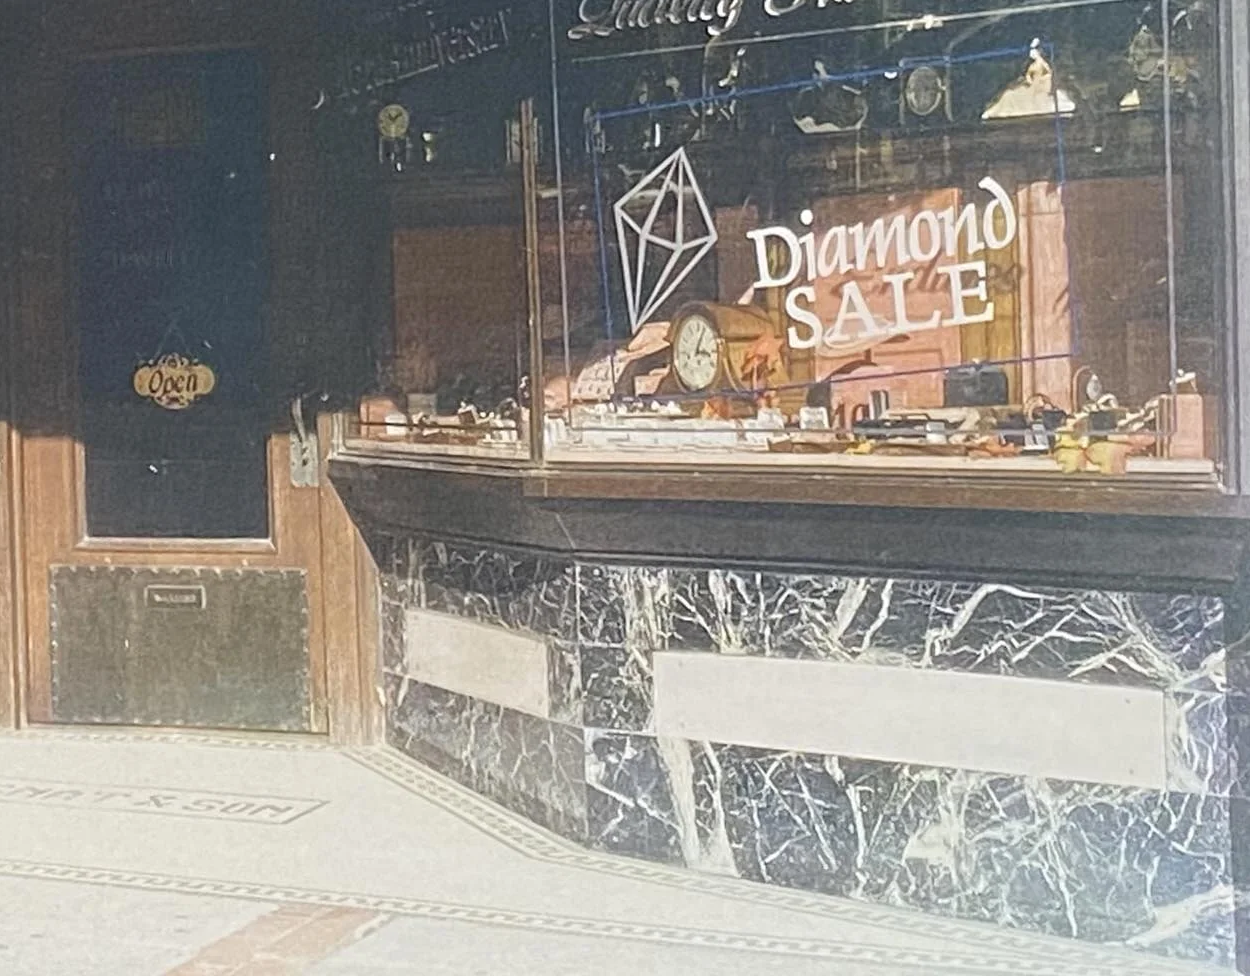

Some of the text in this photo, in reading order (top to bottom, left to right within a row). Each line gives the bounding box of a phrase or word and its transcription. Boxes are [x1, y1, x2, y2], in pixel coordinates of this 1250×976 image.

[746, 176, 1017, 290] Diamond
[785, 260, 995, 351] SALE
[148, 369, 199, 396] Open
